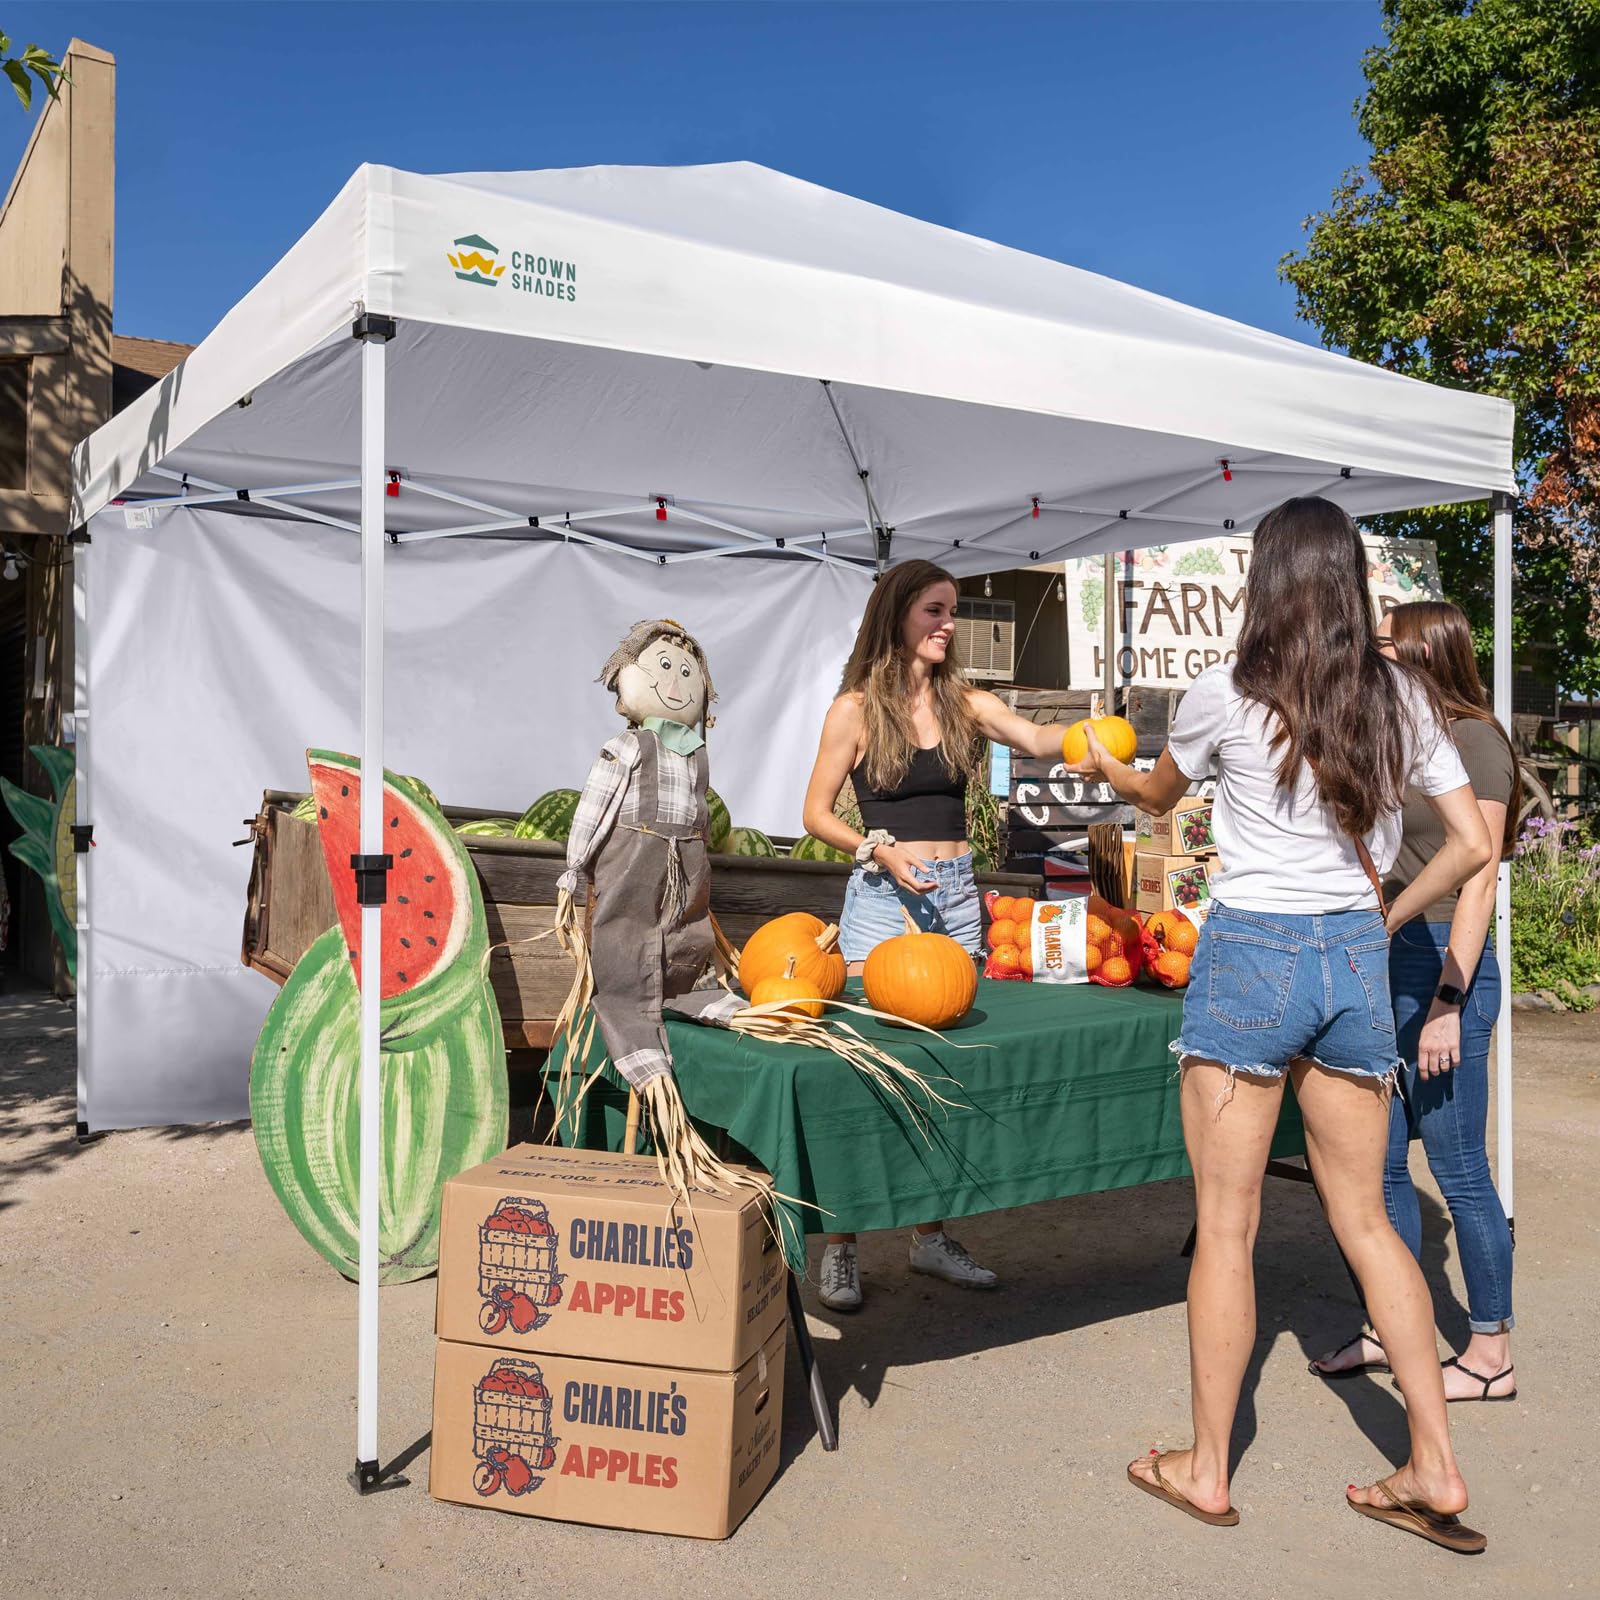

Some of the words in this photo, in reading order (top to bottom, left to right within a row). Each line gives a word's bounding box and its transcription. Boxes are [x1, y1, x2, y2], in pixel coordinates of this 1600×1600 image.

[511, 251, 576, 283] CROWN
[511, 272, 576, 302] SHADES
[1093, 645, 1178, 679] HOME
[1044, 925, 1063, 970] ORANGES
[497, 1169, 546, 1178] KEEP
[615, 1178, 665, 1187] KEEP
[567, 1280, 685, 1322] APPLES
[563, 1381, 687, 1436] CHARLIE'S
[560, 1444, 678, 1488] APPLES
